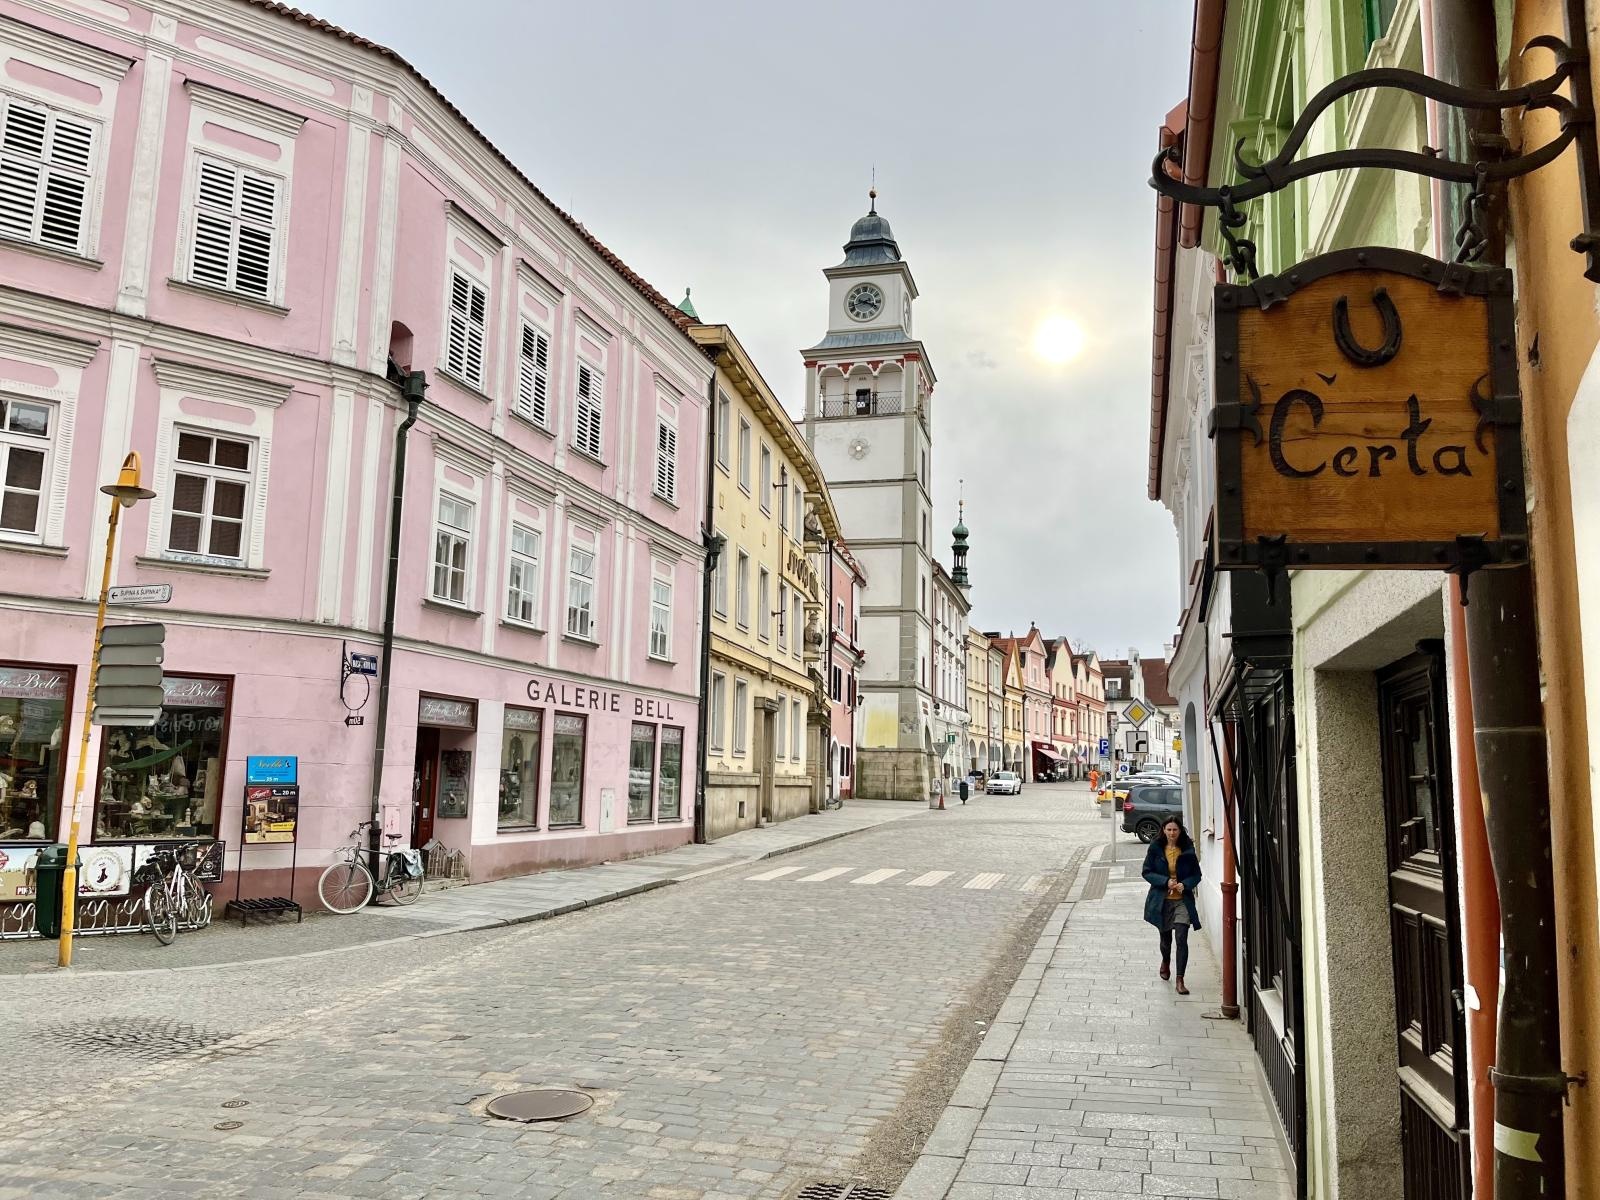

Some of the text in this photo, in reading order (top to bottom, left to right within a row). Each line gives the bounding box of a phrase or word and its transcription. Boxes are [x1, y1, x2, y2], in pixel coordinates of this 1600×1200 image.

[1269, 371, 1473, 478] Čerta
[18, 672, 61, 689] Bell
[182, 681, 220, 698] Bell
[527, 679, 674, 721] GALERIE BELL
